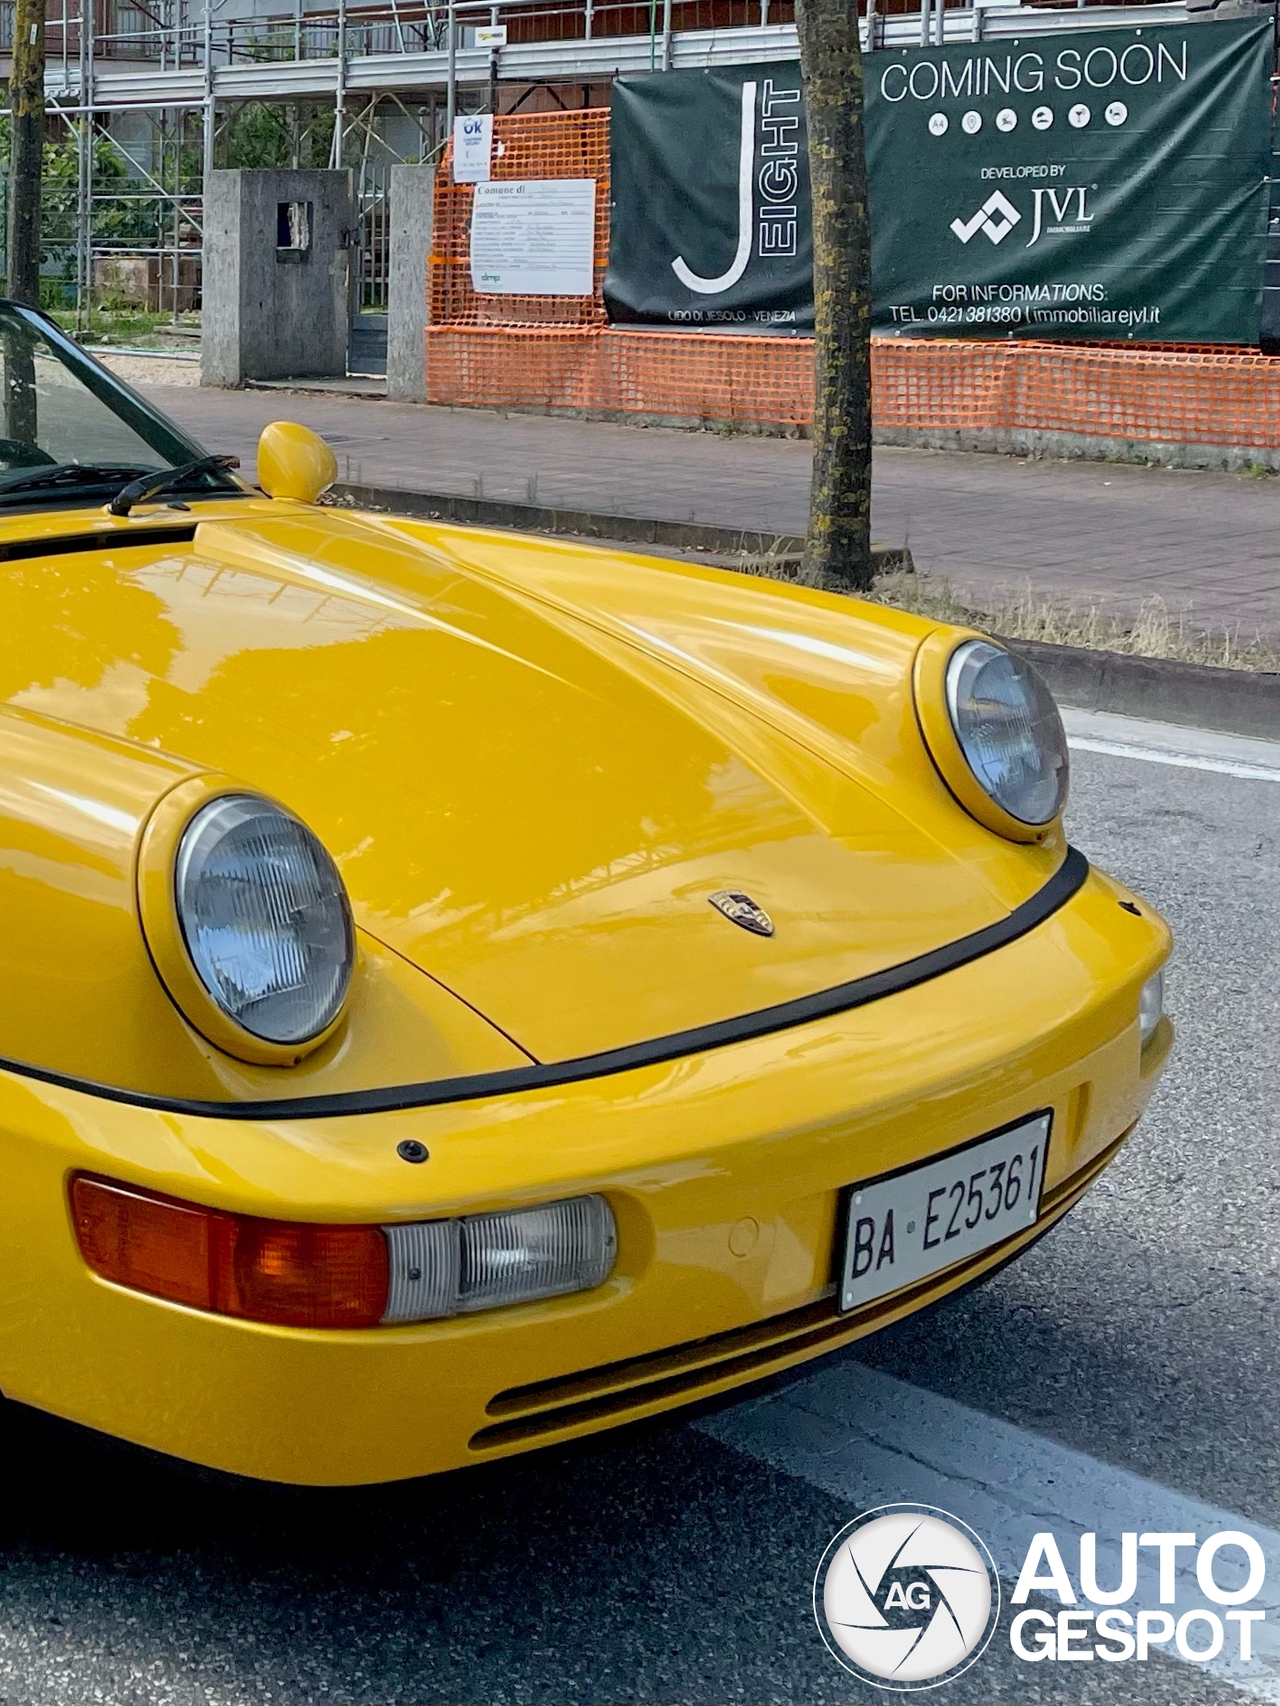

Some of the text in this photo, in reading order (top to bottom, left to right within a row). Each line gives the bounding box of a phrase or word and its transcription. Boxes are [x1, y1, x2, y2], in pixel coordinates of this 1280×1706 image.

[880, 41, 1187, 102] COMING SOON
[932, 119, 944, 129] A4
[758, 79, 801, 257] EIGHT
[981, 165, 1066, 179] DEVELOPED BY
[477, 186, 514, 194] Comune
[516, 185, 526, 194] di
[671, 81, 757, 294] J
[1026, 187, 1095, 248] JVL
[481, 272, 501, 283] dmp
[932, 284, 1108, 301] FOR INFORMATIONS:
[668, 311, 692, 321] LIDO
[693, 311, 704, 321] DI
[705, 311, 746, 321] JESOLO
[754, 310, 796, 321] VENEZIA
[888, 306, 925, 322] TEL.
[1033, 306, 1161, 326] immobiliarejvl.it
[851, 1144, 1039, 1279] BA E25361
